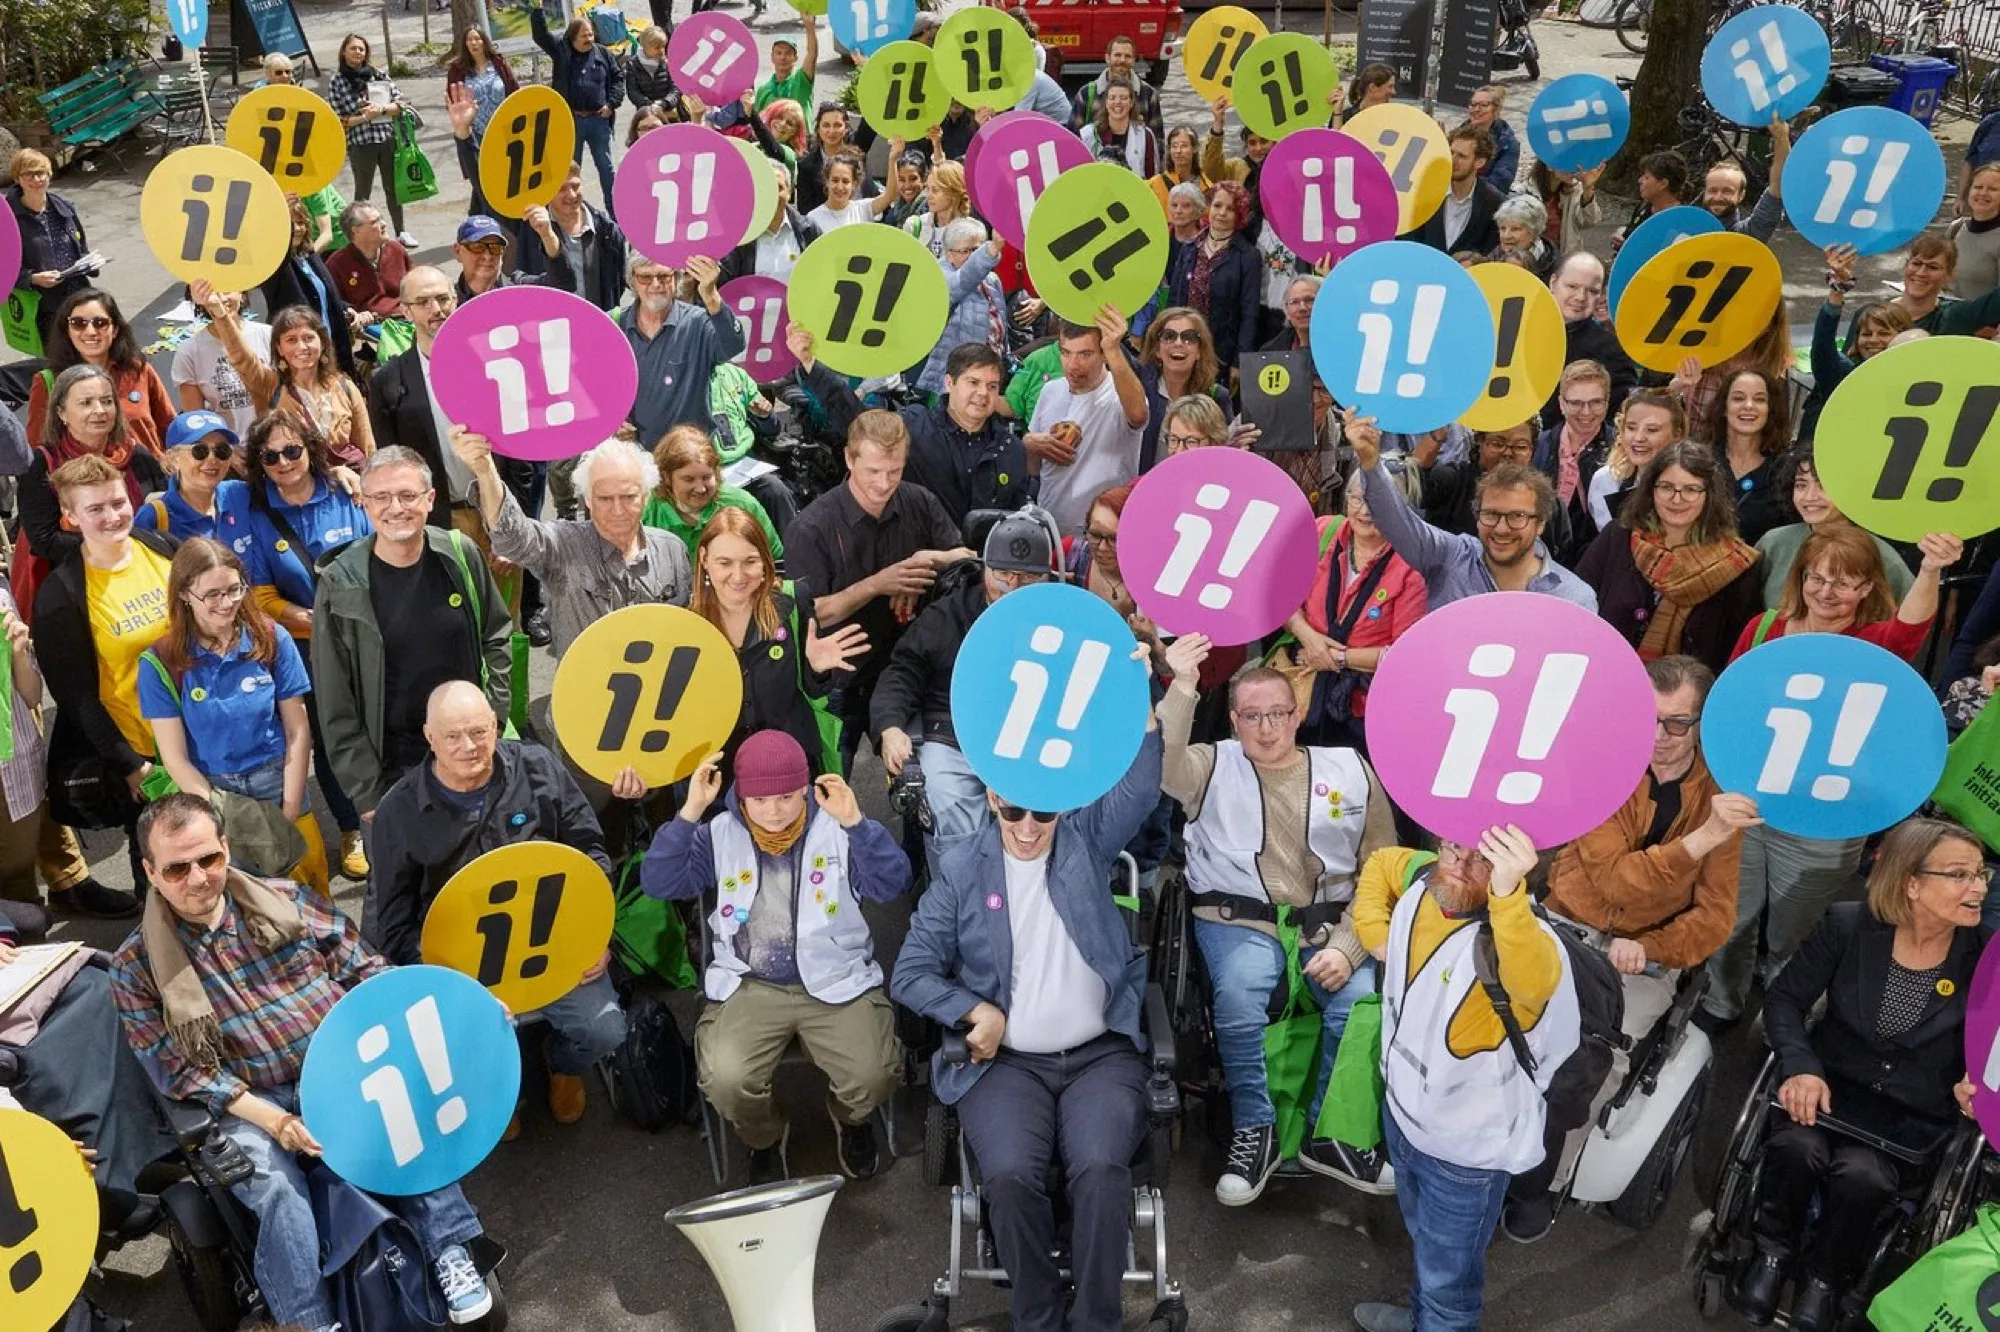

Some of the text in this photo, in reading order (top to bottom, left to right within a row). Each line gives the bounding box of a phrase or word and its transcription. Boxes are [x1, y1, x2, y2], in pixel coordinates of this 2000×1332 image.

[679, 28, 746, 89] i!
[961, 28, 1003, 93] i!
[1259, 50, 1309, 127] i!
[1730, 20, 1798, 111] i!
[259, 107, 316, 178] i!
[505, 108, 551, 199] i!
[1813, 135, 1911, 229] i!
[180, 174, 252, 266] i!
[651, 151, 716, 245] i!
[825, 255, 912, 348] i!
[1355, 279, 1447, 398] i!
[1644, 260, 1753, 347] i!
[484, 317, 576, 435] i!
[1872, 381, 2000, 502] i!
[1153, 483, 1280, 610] i!
[596, 640, 701, 753] i!
[993, 624, 1112, 769] i!
[1430, 643, 1590, 805] i!
[1756, 673, 1888, 801] i!
[1963, 776, 2000, 815] initia
[476, 872, 567, 989] i!
[356, 994, 467, 1167] i!
